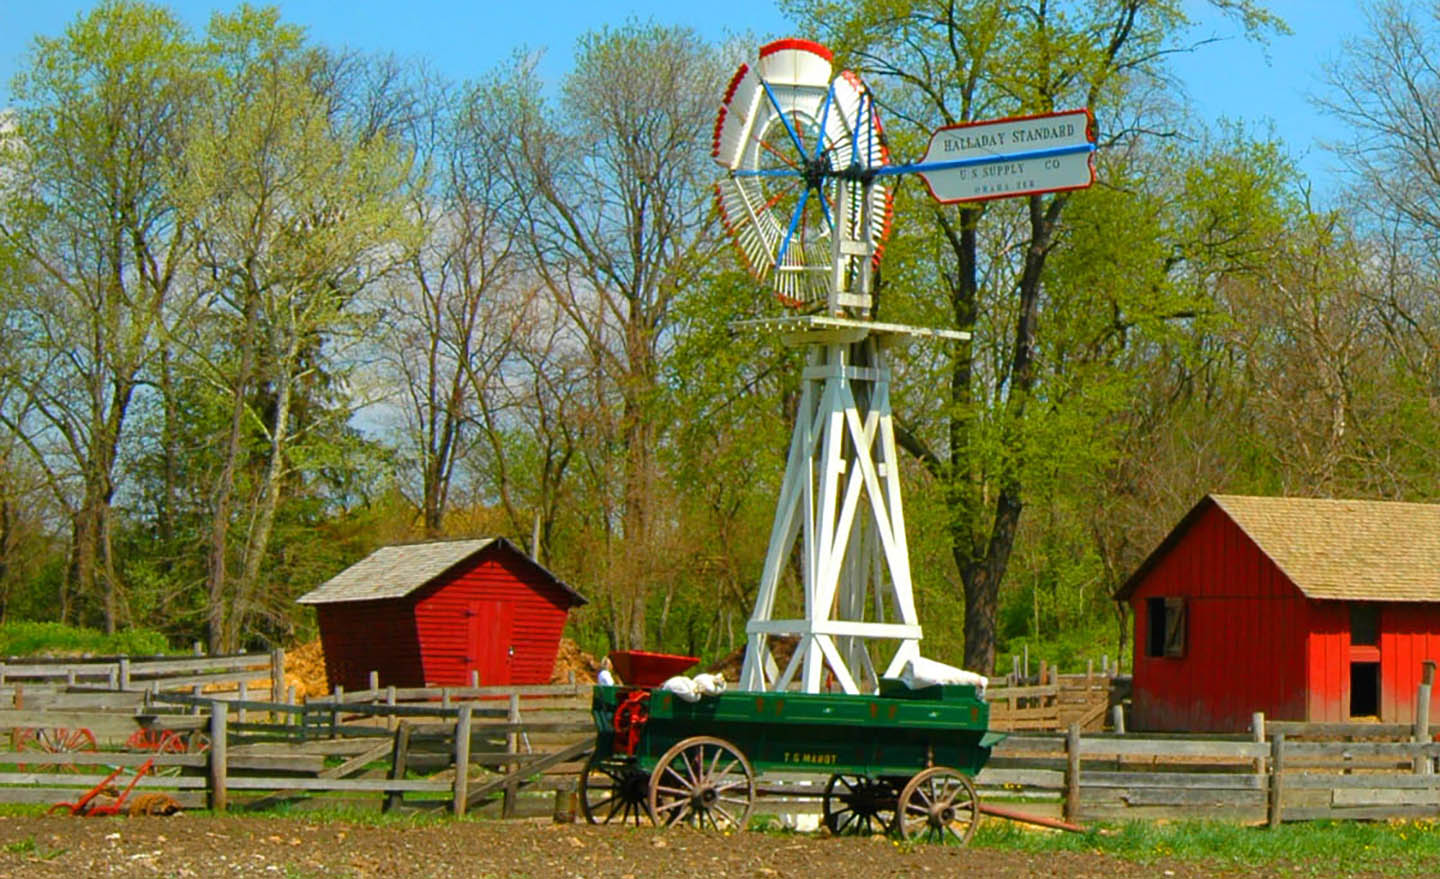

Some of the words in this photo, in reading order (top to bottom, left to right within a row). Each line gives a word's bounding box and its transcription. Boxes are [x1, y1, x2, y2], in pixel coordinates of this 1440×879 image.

[944, 132, 1006, 152] HALLADAY
[1012, 124, 1074, 143] STANDARD
[982, 163, 1024, 178] SUPPLY
